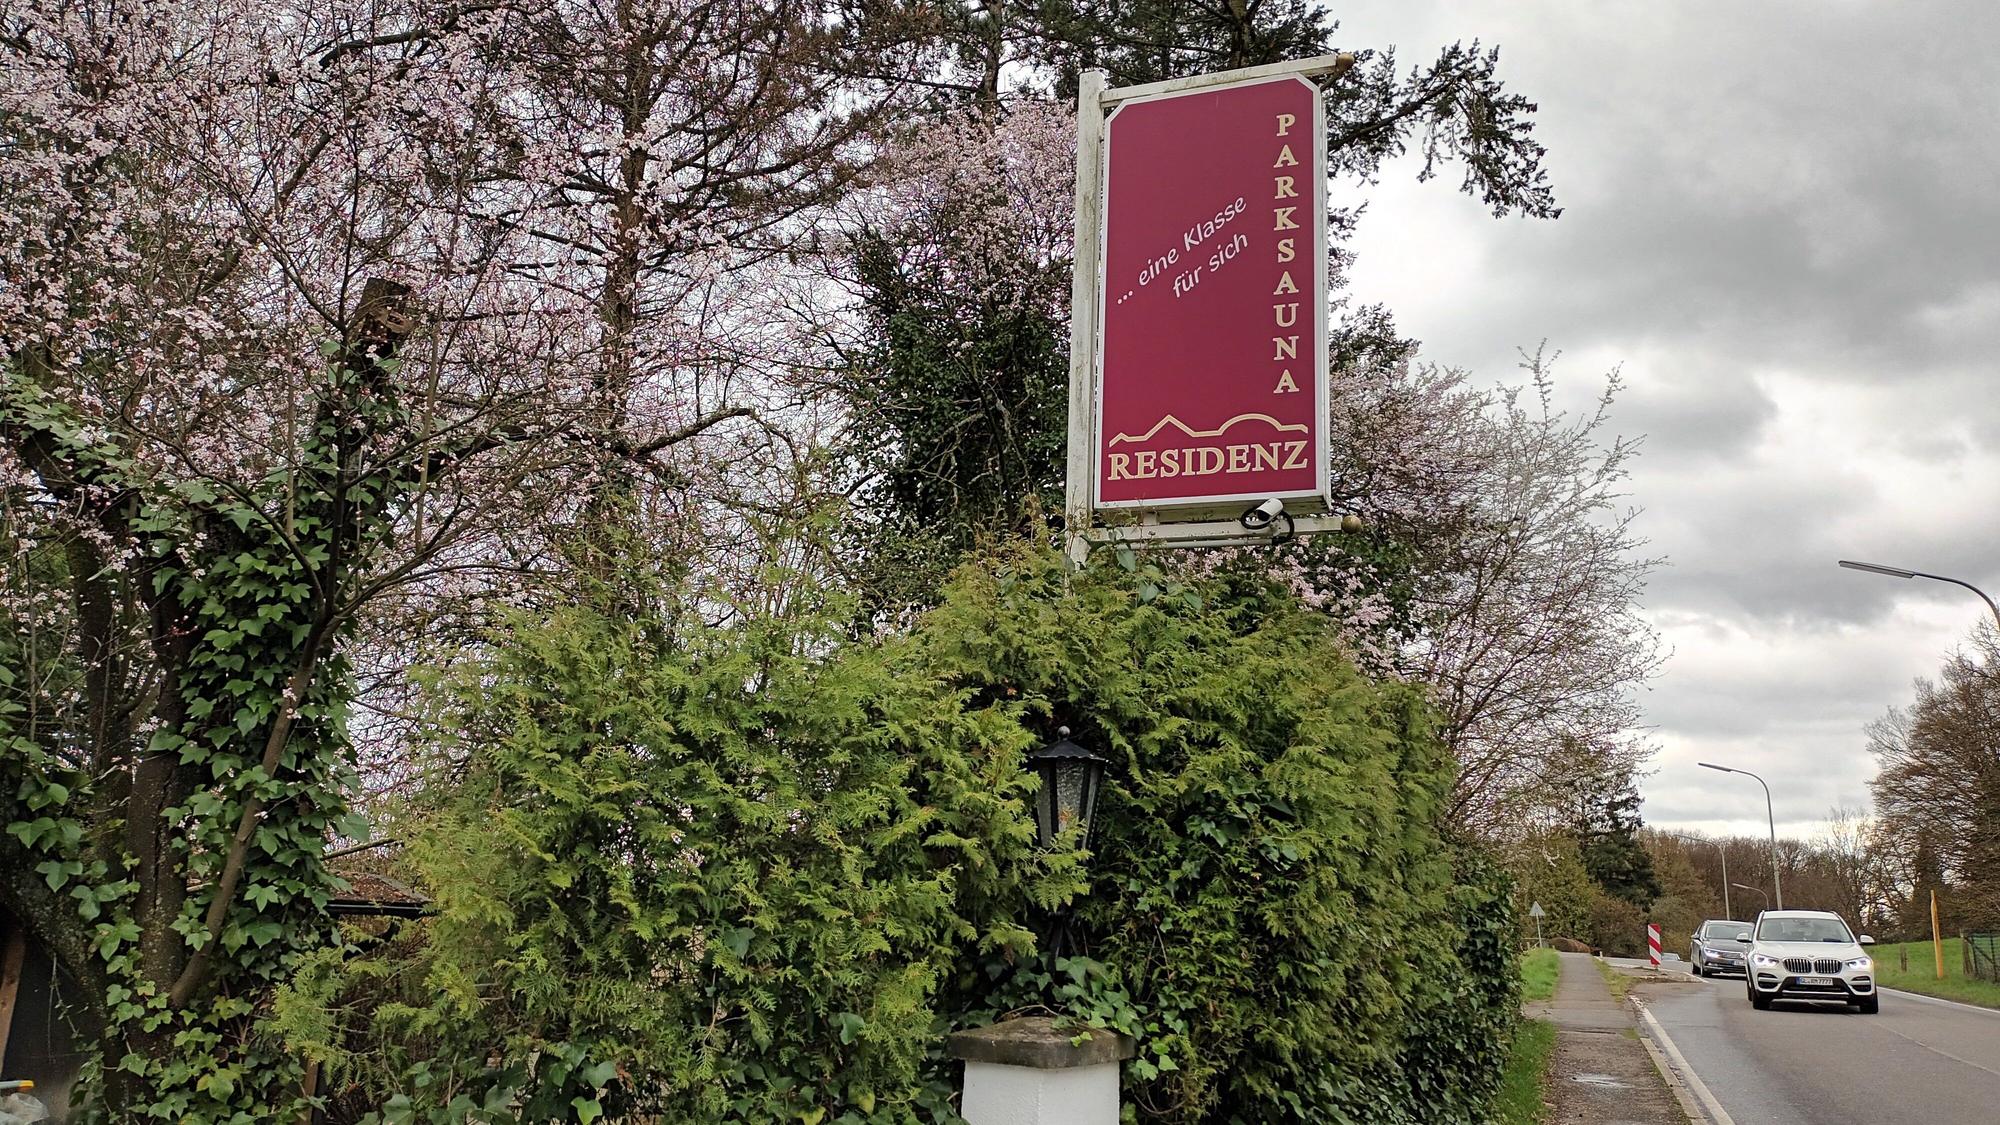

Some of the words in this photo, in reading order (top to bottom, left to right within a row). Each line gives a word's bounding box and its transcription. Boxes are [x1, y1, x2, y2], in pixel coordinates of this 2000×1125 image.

[1138, 248, 1180, 286] eine
[1183, 197, 1247, 252] Klasse
[1172, 266, 1202, 298] für
[1208, 233, 1248, 272] sich
[1273, 113, 1299, 394] PARKSAUNA
[1107, 441, 1308, 481] RESIDENZ
